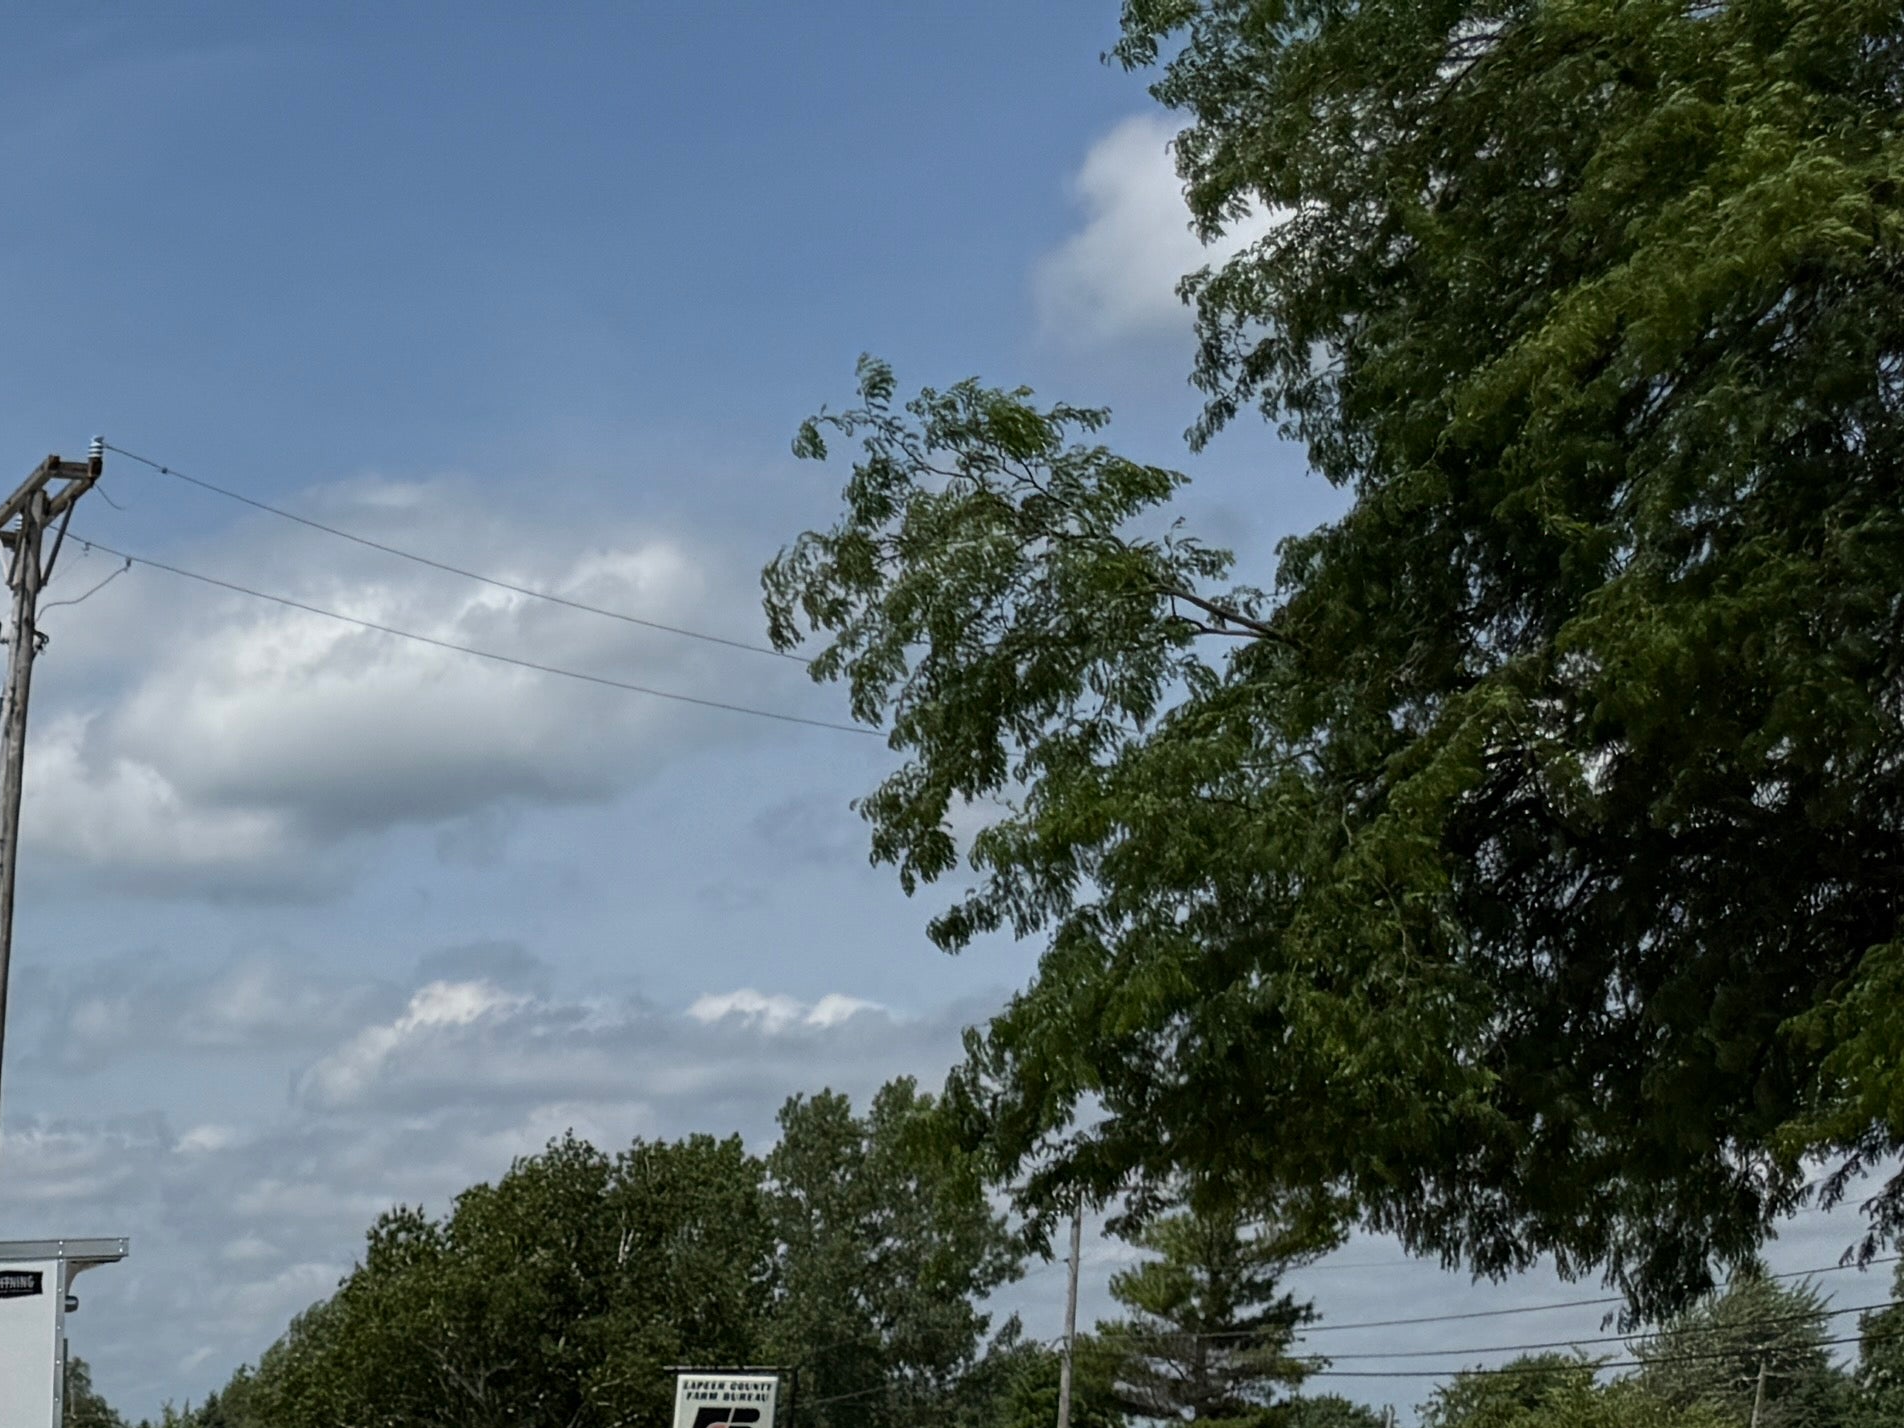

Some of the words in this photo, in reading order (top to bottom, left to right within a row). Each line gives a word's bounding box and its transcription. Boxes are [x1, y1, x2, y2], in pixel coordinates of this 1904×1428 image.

[730, 1382, 772, 1391] COUNTY
[686, 1391, 718, 1401] FARM
[723, 1392, 769, 1402] BUREAU
